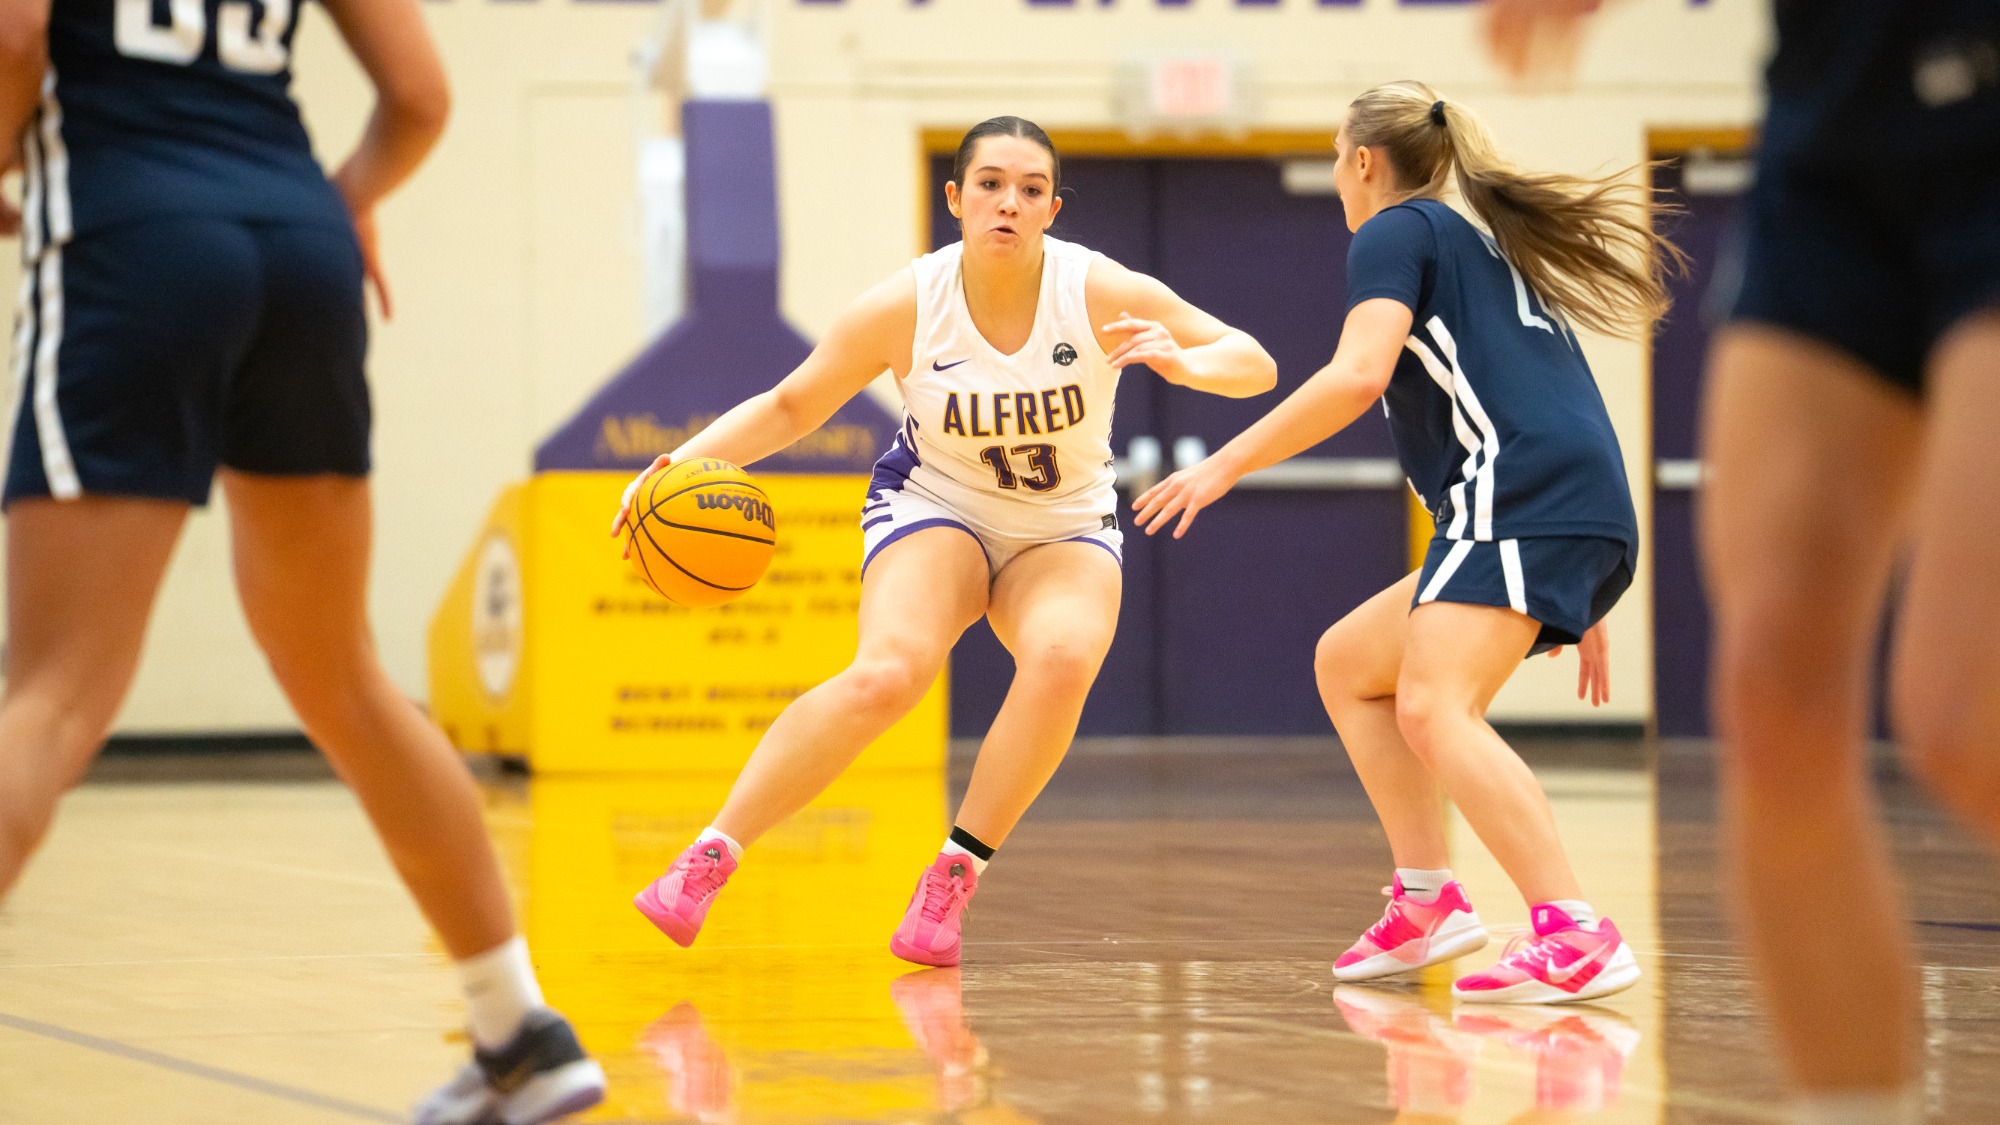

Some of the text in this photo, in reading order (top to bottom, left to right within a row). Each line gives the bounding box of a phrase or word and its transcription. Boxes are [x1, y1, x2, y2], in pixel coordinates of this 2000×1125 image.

[943, 384, 1085, 437] ALFRED
[980, 443, 1061, 492] 13
[697, 493, 775, 531] Wilson
